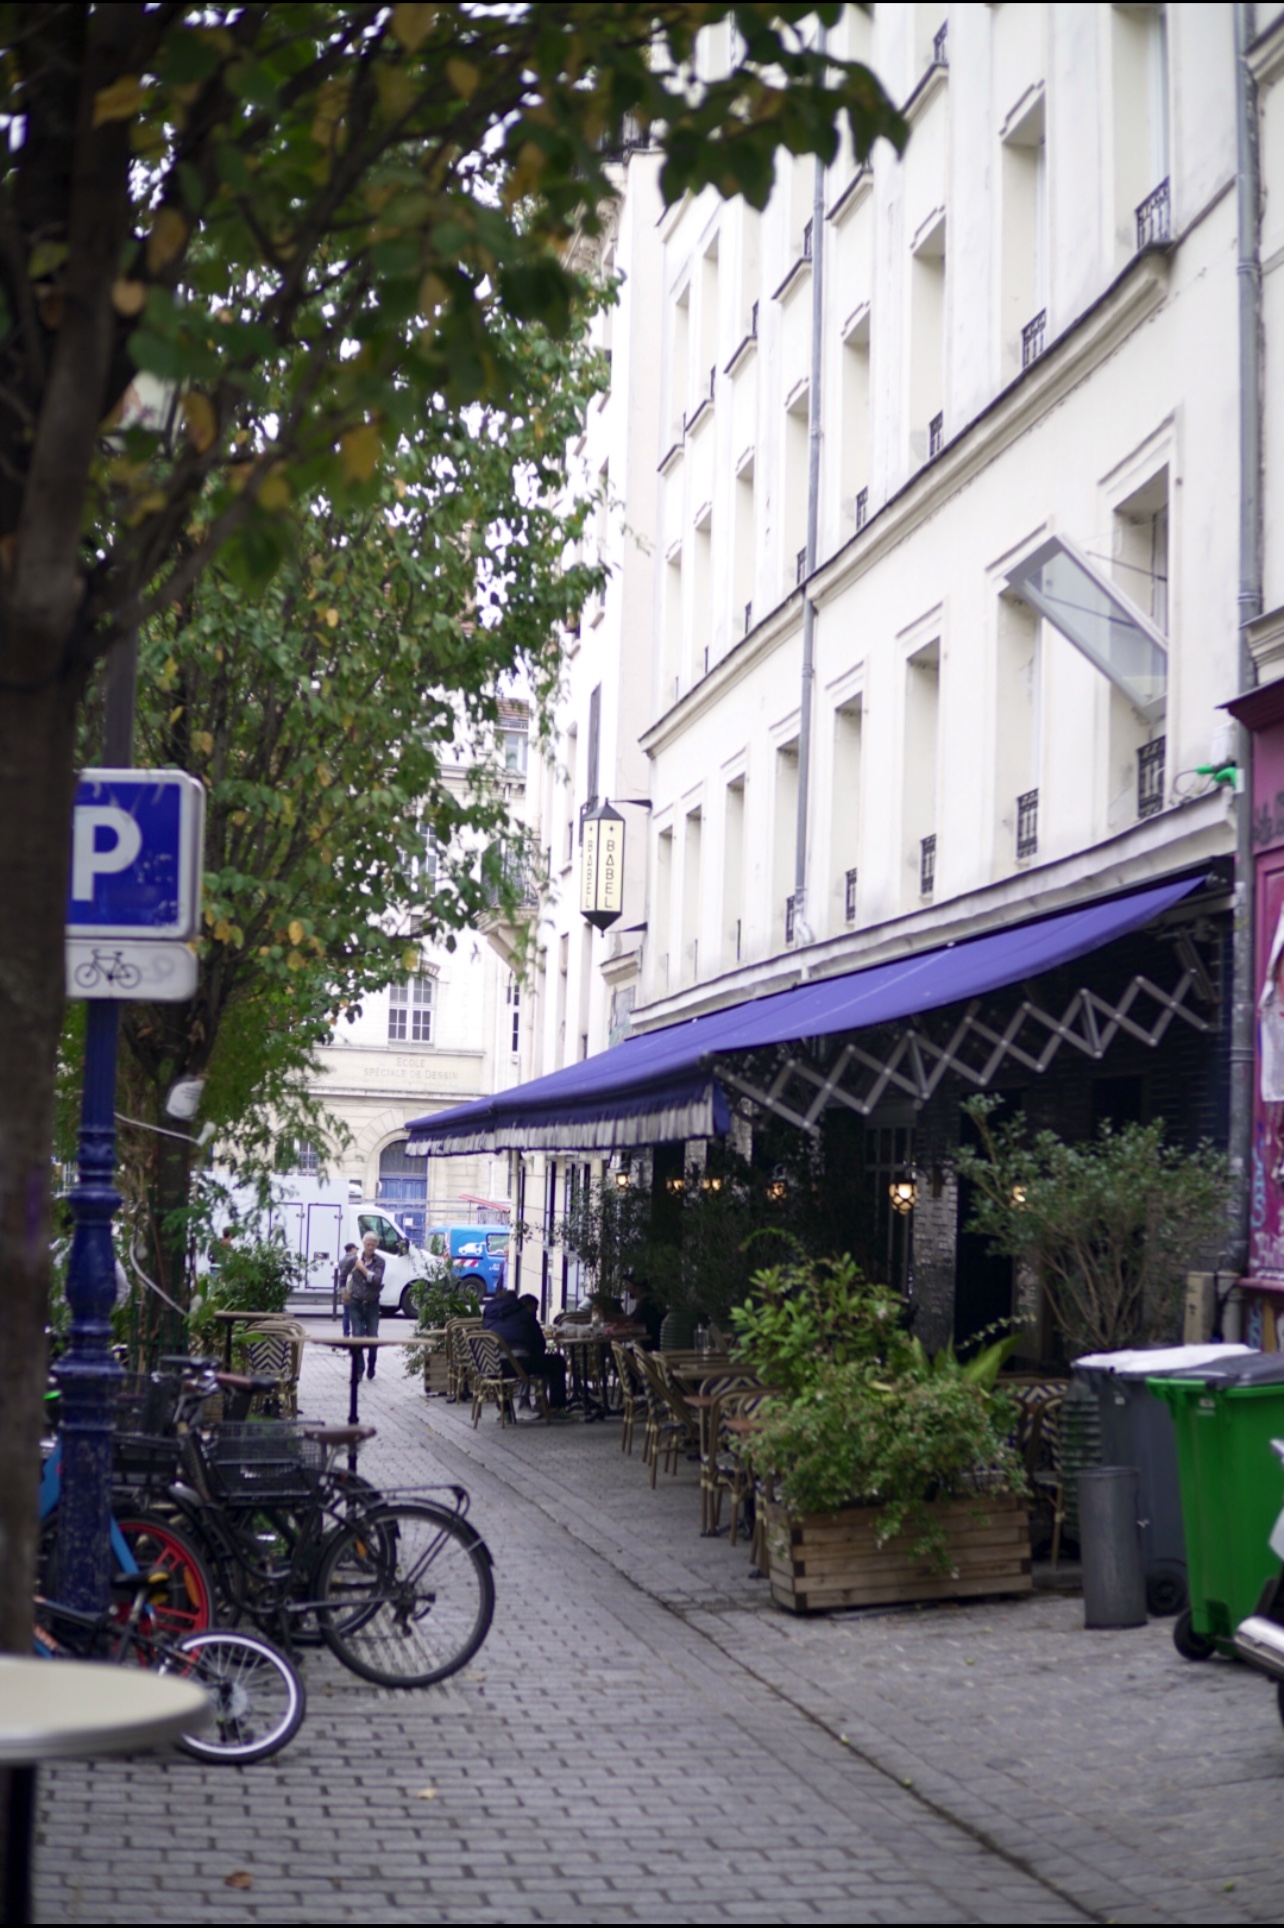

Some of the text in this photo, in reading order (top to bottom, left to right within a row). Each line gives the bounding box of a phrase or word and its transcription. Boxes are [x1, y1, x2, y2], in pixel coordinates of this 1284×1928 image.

[72, 805, 143, 901] P
[604, 839, 615, 909] BABEL
[410, 1069, 422, 1079] DE
[425, 1069, 458, 1080] DESSIN
